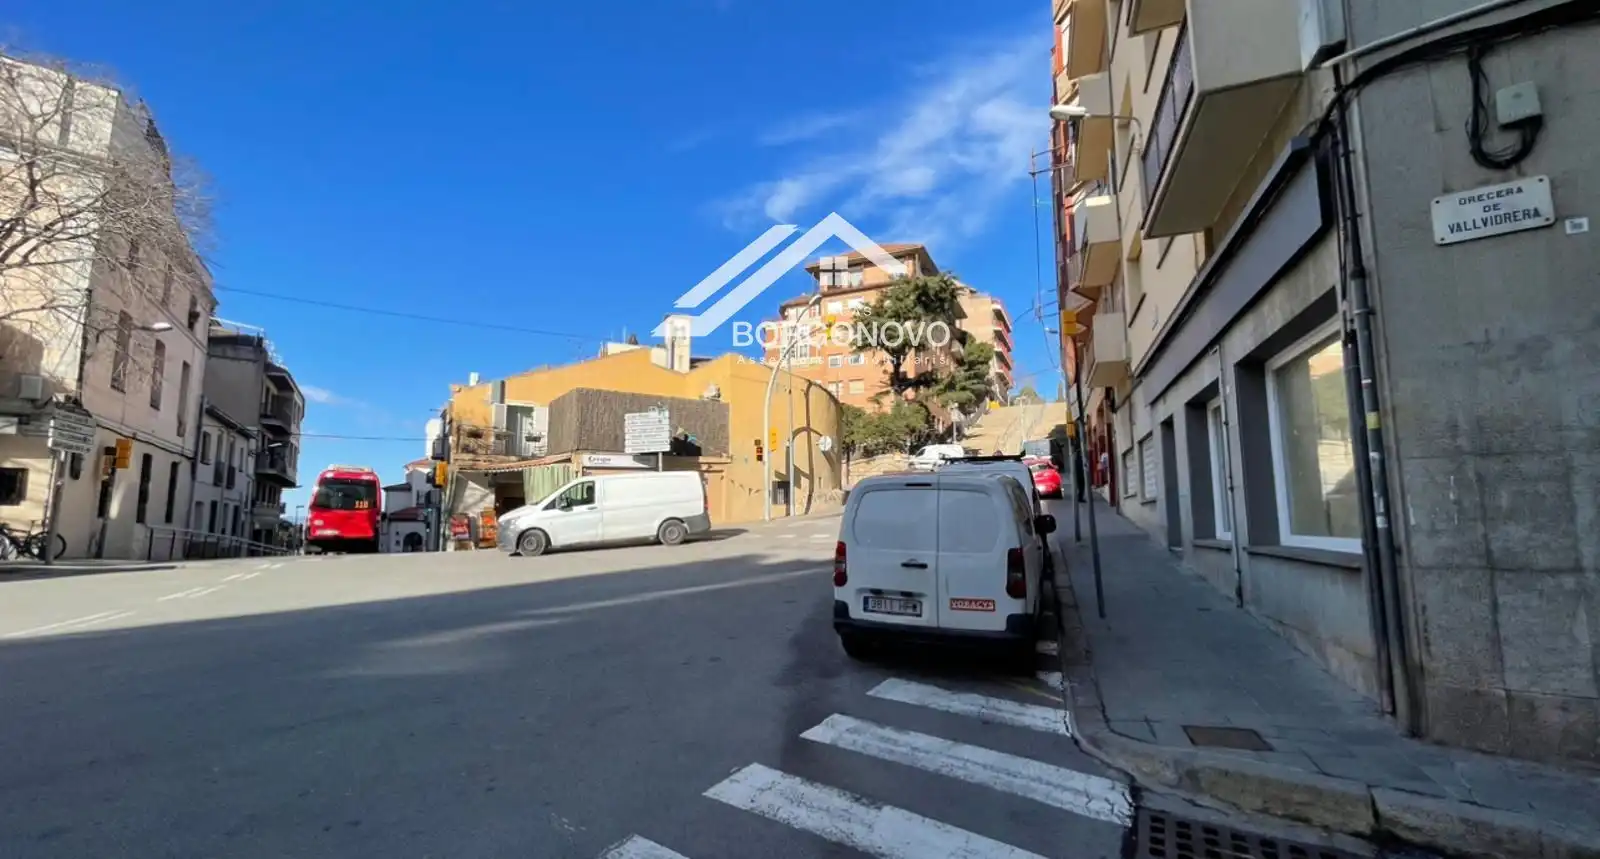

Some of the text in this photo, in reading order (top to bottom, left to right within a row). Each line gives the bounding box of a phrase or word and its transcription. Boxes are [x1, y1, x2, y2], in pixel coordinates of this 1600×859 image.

[1458, 186, 1524, 206] DRECERA
[1482, 202, 1502, 213] DE
[1448, 207, 1542, 234] VALLVIDRERA
